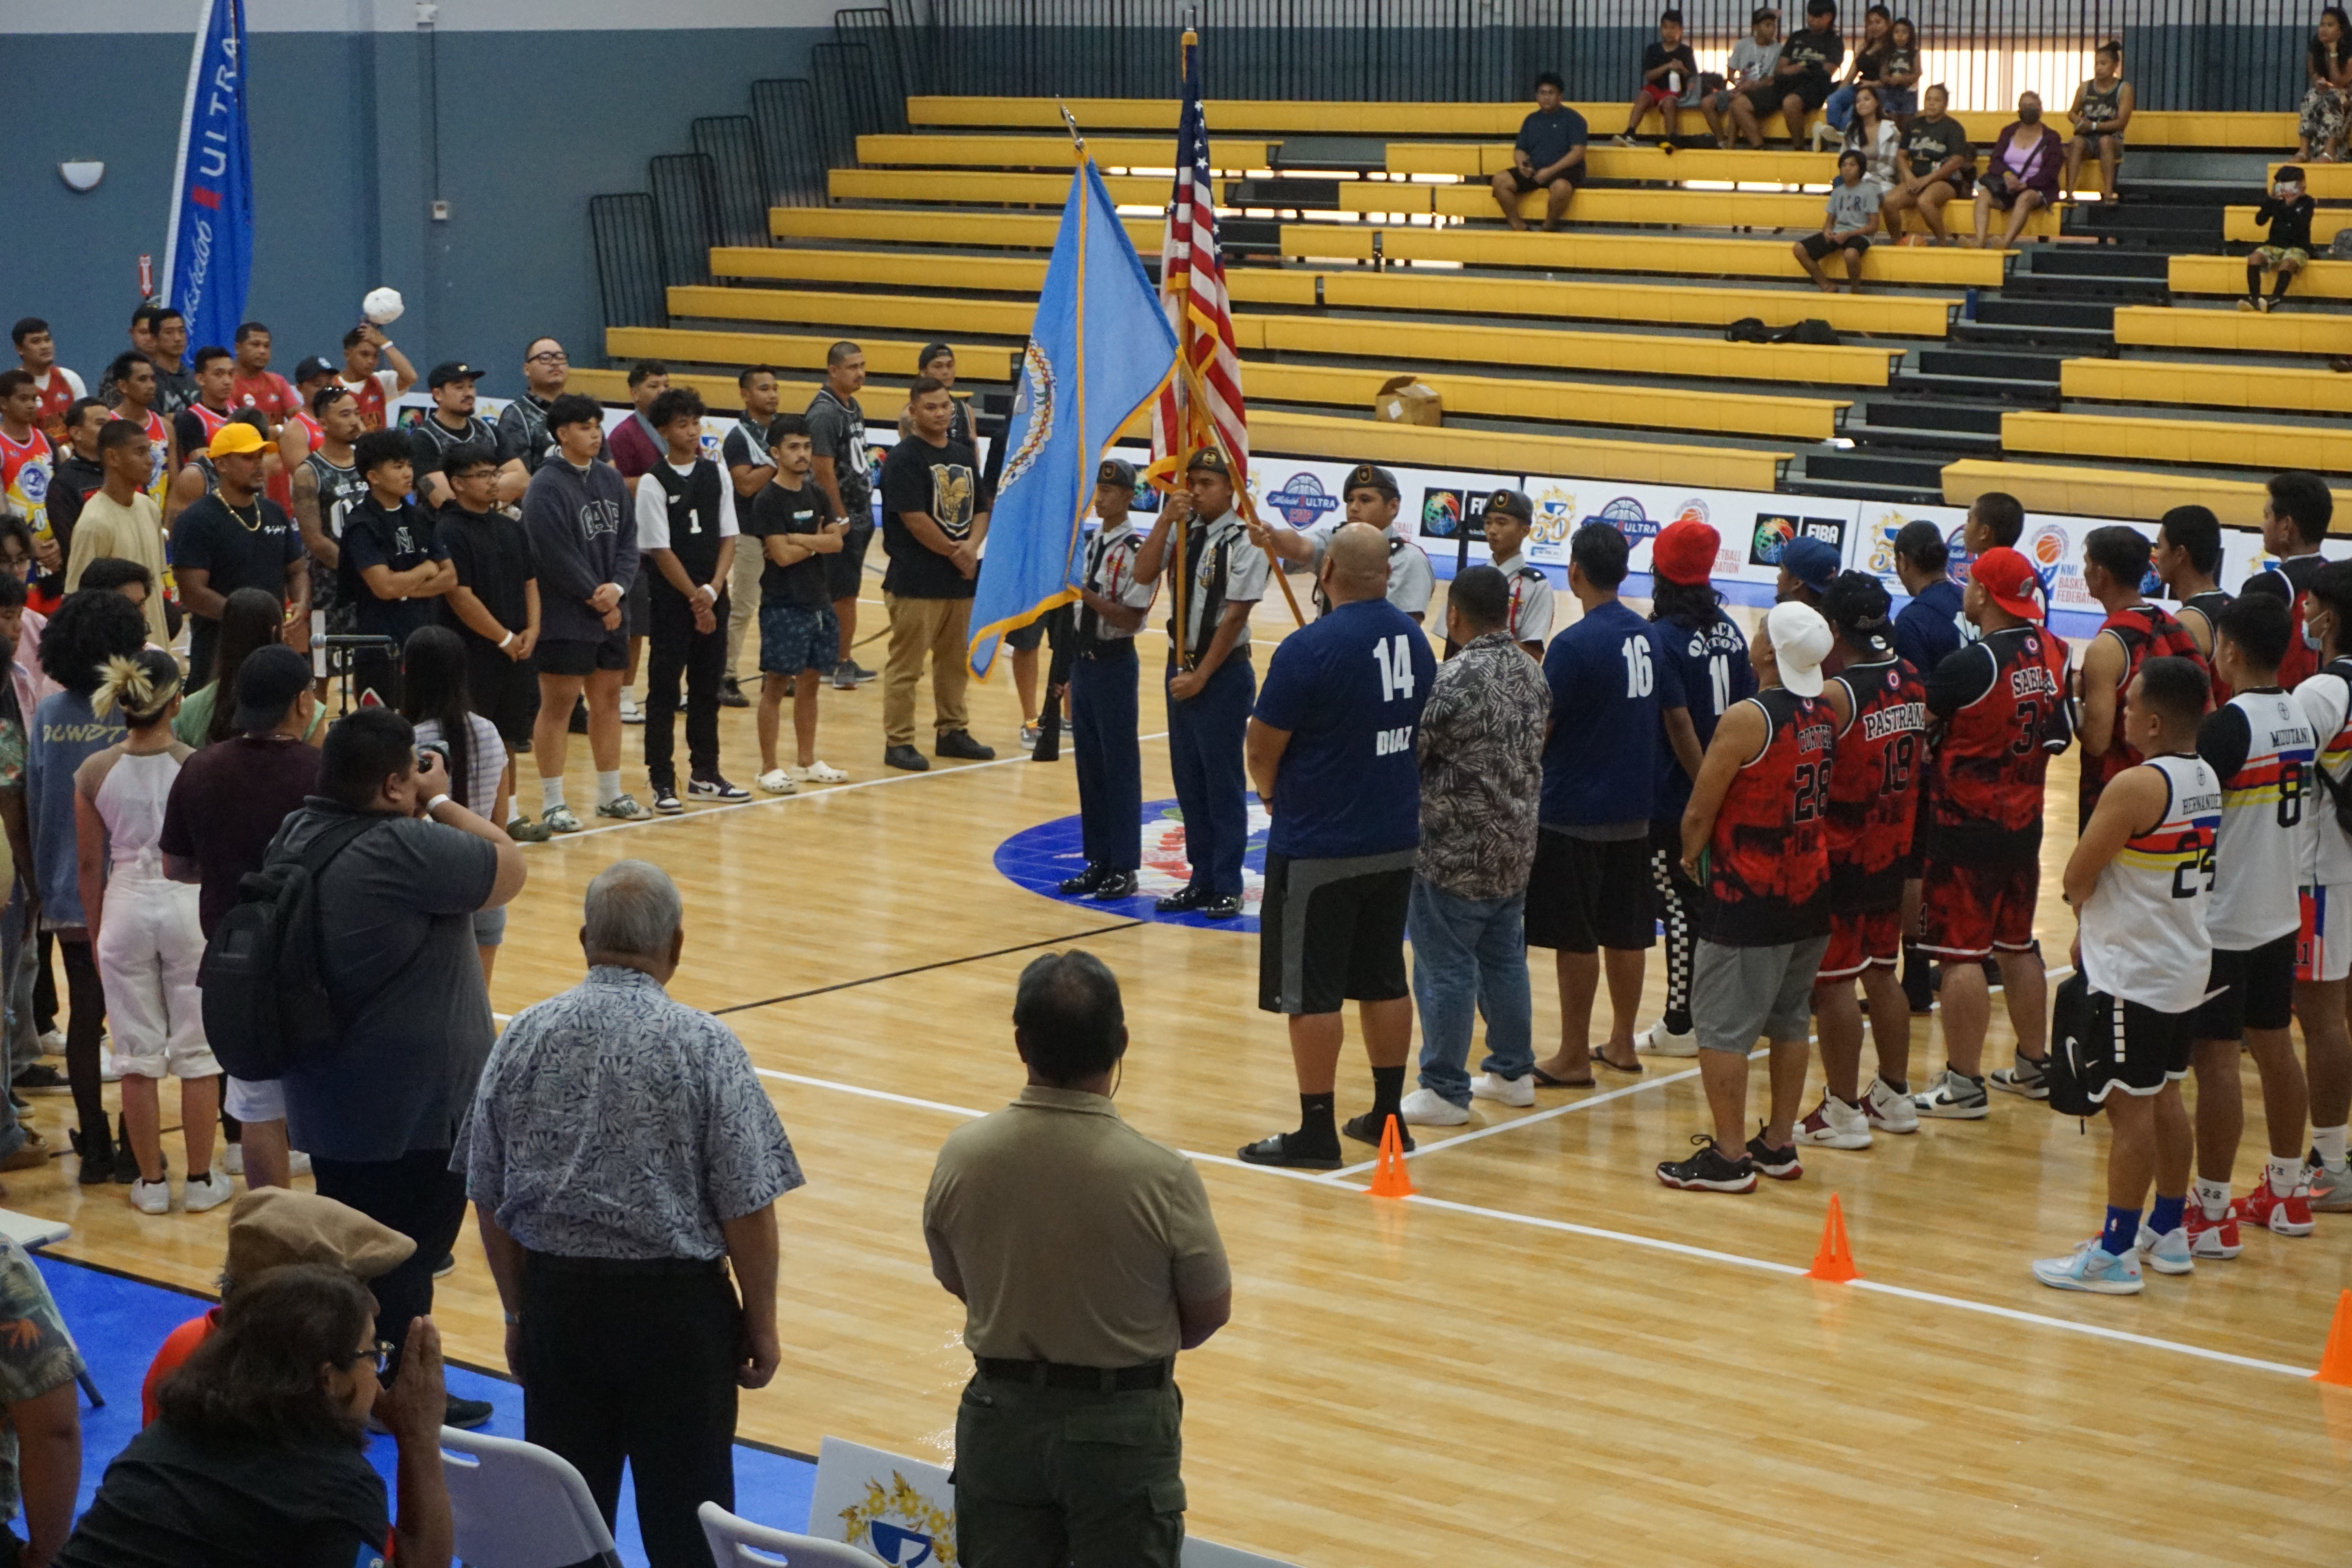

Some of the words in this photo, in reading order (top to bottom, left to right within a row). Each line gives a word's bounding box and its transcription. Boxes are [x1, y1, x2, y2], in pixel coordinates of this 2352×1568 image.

[200, 38, 240, 177] ULTRA
[1289, 508, 1312, 523] CUP
[1305, 497, 1336, 509] ULTRA
[688, 509, 702, 534] 1
[1624, 524, 1658, 535] ULTRA
[1806, 523, 1839, 544] FIBA
[1712, 562, 1739, 574] RATION
[1717, 548, 1742, 562] ETBALL
[2058, 577, 2088, 590] BASKE
[2060, 564, 2078, 576] NMI
[1372, 634, 1415, 702] 14
[1621, 635, 1653, 699] 16
[1709, 654, 1730, 716] 11
[1376, 725, 1413, 756] DIAZ
[1798, 724, 1832, 755] CORTEZ
[2012, 699, 2039, 755] 3
[1793, 757, 1833, 824] 28
[2277, 760, 2303, 828] 8
